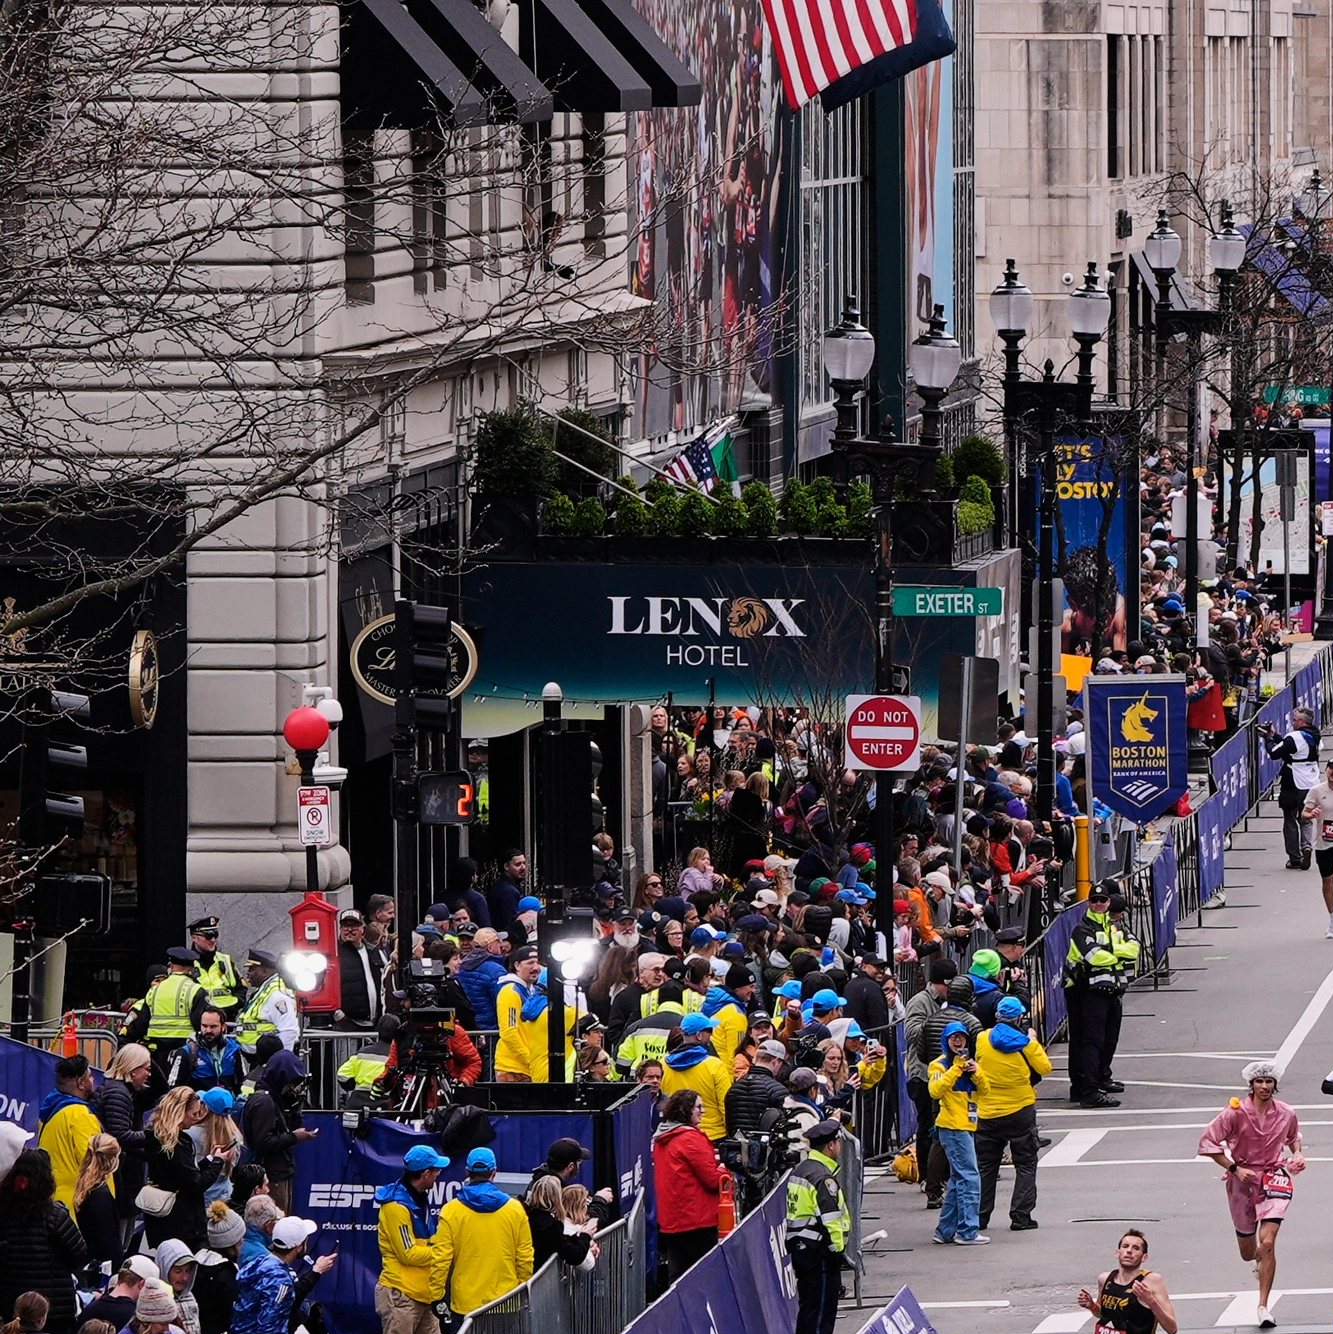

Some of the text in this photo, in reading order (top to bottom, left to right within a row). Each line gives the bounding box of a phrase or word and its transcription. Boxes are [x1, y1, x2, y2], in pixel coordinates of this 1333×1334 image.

[915, 594, 989, 613] EXETER ST
[666, 645, 749, 667] HOTEL
[858, 710, 908, 723] DO NOT
[862, 743, 903, 755] ENTER
[1112, 746, 1166, 759] BOSTON
[1112, 759, 1166, 768] MARATHON
